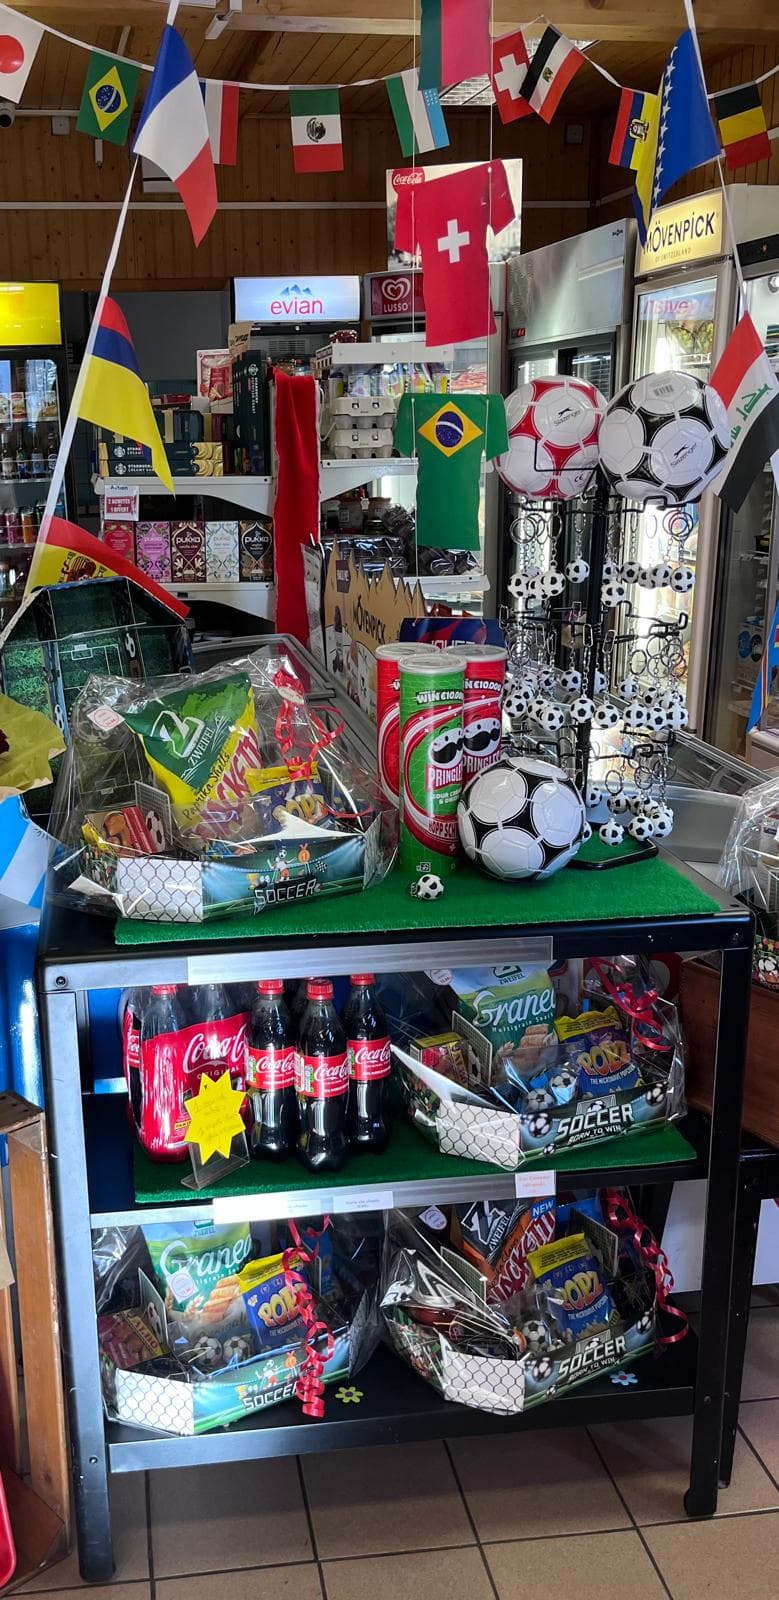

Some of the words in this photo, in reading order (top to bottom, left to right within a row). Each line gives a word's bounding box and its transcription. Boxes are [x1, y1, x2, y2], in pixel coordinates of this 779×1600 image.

[271, 297, 322, 314] evian
[383, 303, 408, 312] LUSSO
[176, 536, 200, 544] pukka
[245, 536, 268, 544] pukka
[416, 691, 440, 703] WIN
[188, 727, 216, 767] ZWEIFEL
[427, 765, 463, 790] PRINGLE
[254, 879, 317, 906] SOCCER
[555, 1103, 635, 1142] SOCCER
[593, 1127, 603, 1135] TO
[605, 1124, 621, 1133] WIN
[532, 1199, 555, 1217] NEW
[556, 1335, 626, 1382] SOCCER
[590, 1362, 600, 1370] TO
[601, 1356, 616, 1366] WIN
